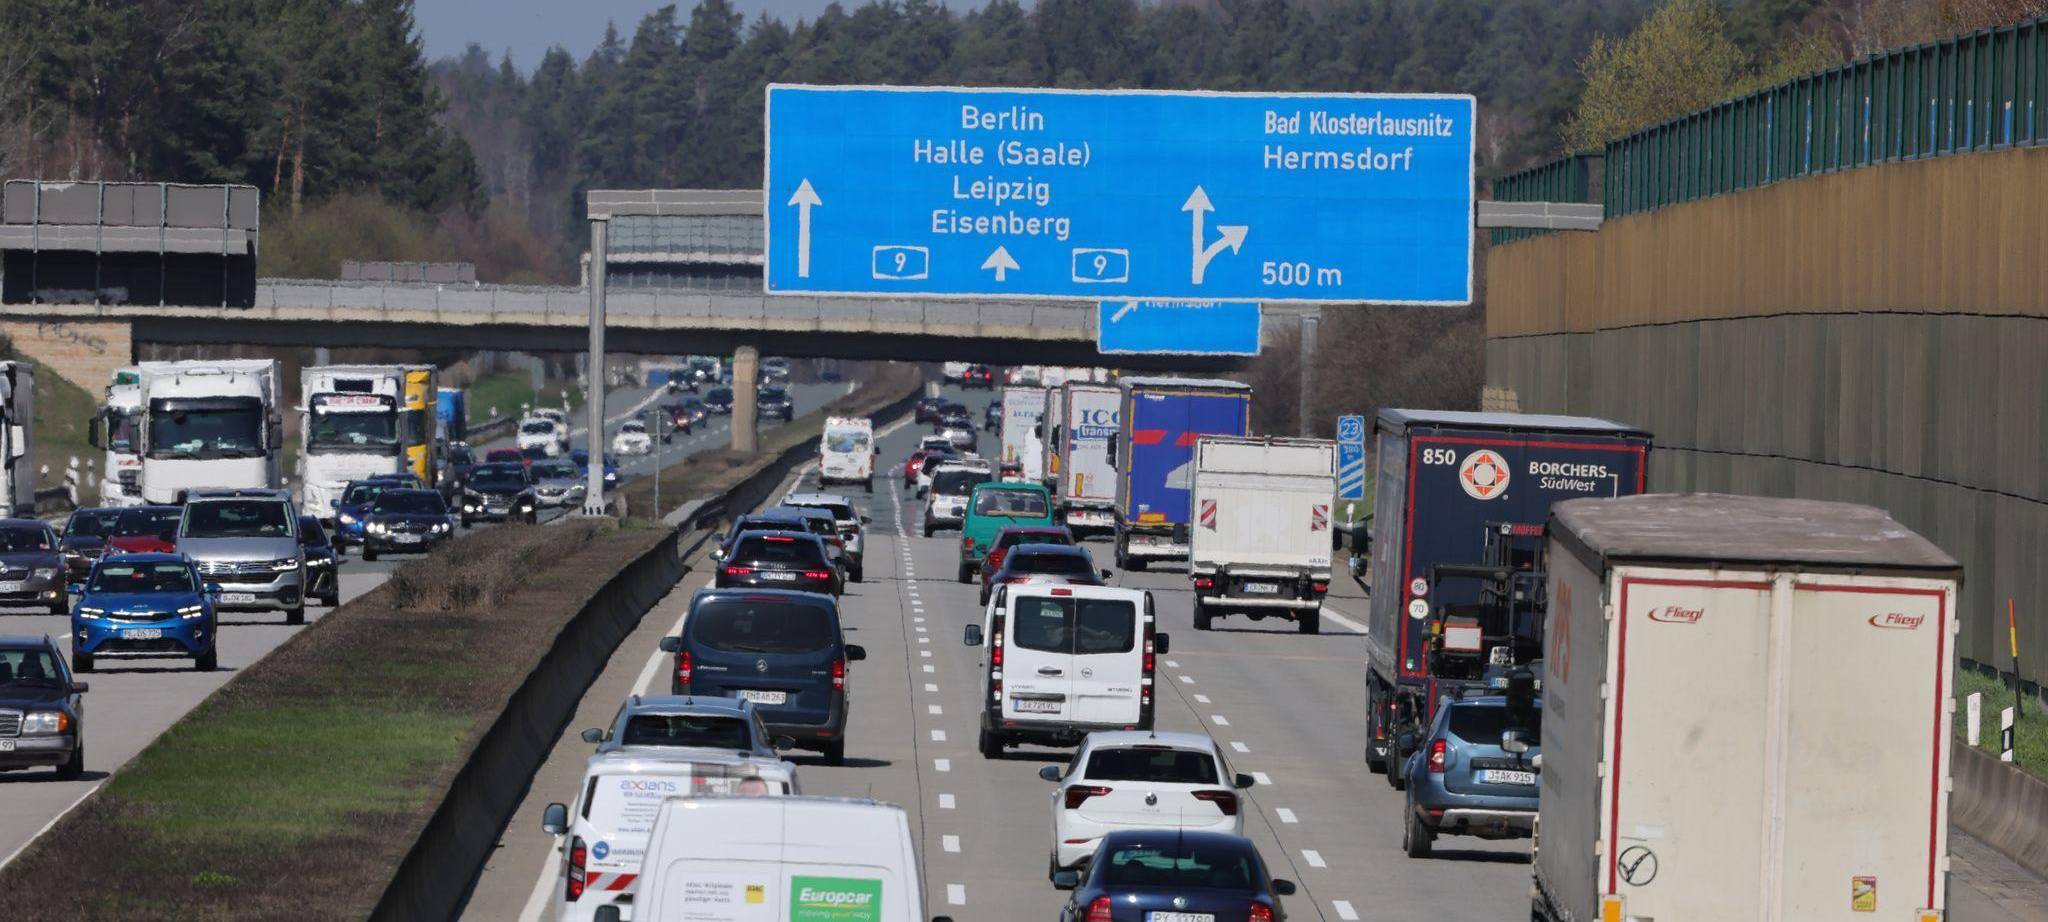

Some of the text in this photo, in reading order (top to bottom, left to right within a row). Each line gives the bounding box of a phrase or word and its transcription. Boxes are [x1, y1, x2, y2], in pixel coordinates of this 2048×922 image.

[962, 105, 1044, 131] Berlin
[1264, 111, 1453, 137] Bad Klosterlausnitz
[913, 139, 1090, 167] Halle (Saale)
[1263, 145, 1413, 171] Hermsdorf
[953, 175, 1050, 207] Leipzig
[931, 209, 1070, 241] Eisenberg
[894, 252, 907, 273] 9
[1093, 254, 1107, 276] 9
[1262, 262, 1342, 287] 500 m
[1343, 422, 1359, 434] 23
[1422, 448, 1456, 466] 850
[1529, 461, 1607, 479] BORCHERS
[1539, 475, 1596, 492] SüdWest
[1414, 582, 1424, 591] 80
[1414, 604, 1424, 613] 70
[1664, 606, 1704, 621] Fliegl
[1885, 613, 1925, 628] Fliegl
[620, 779, 677, 792] axians
[800, 887, 872, 906] Europcar
